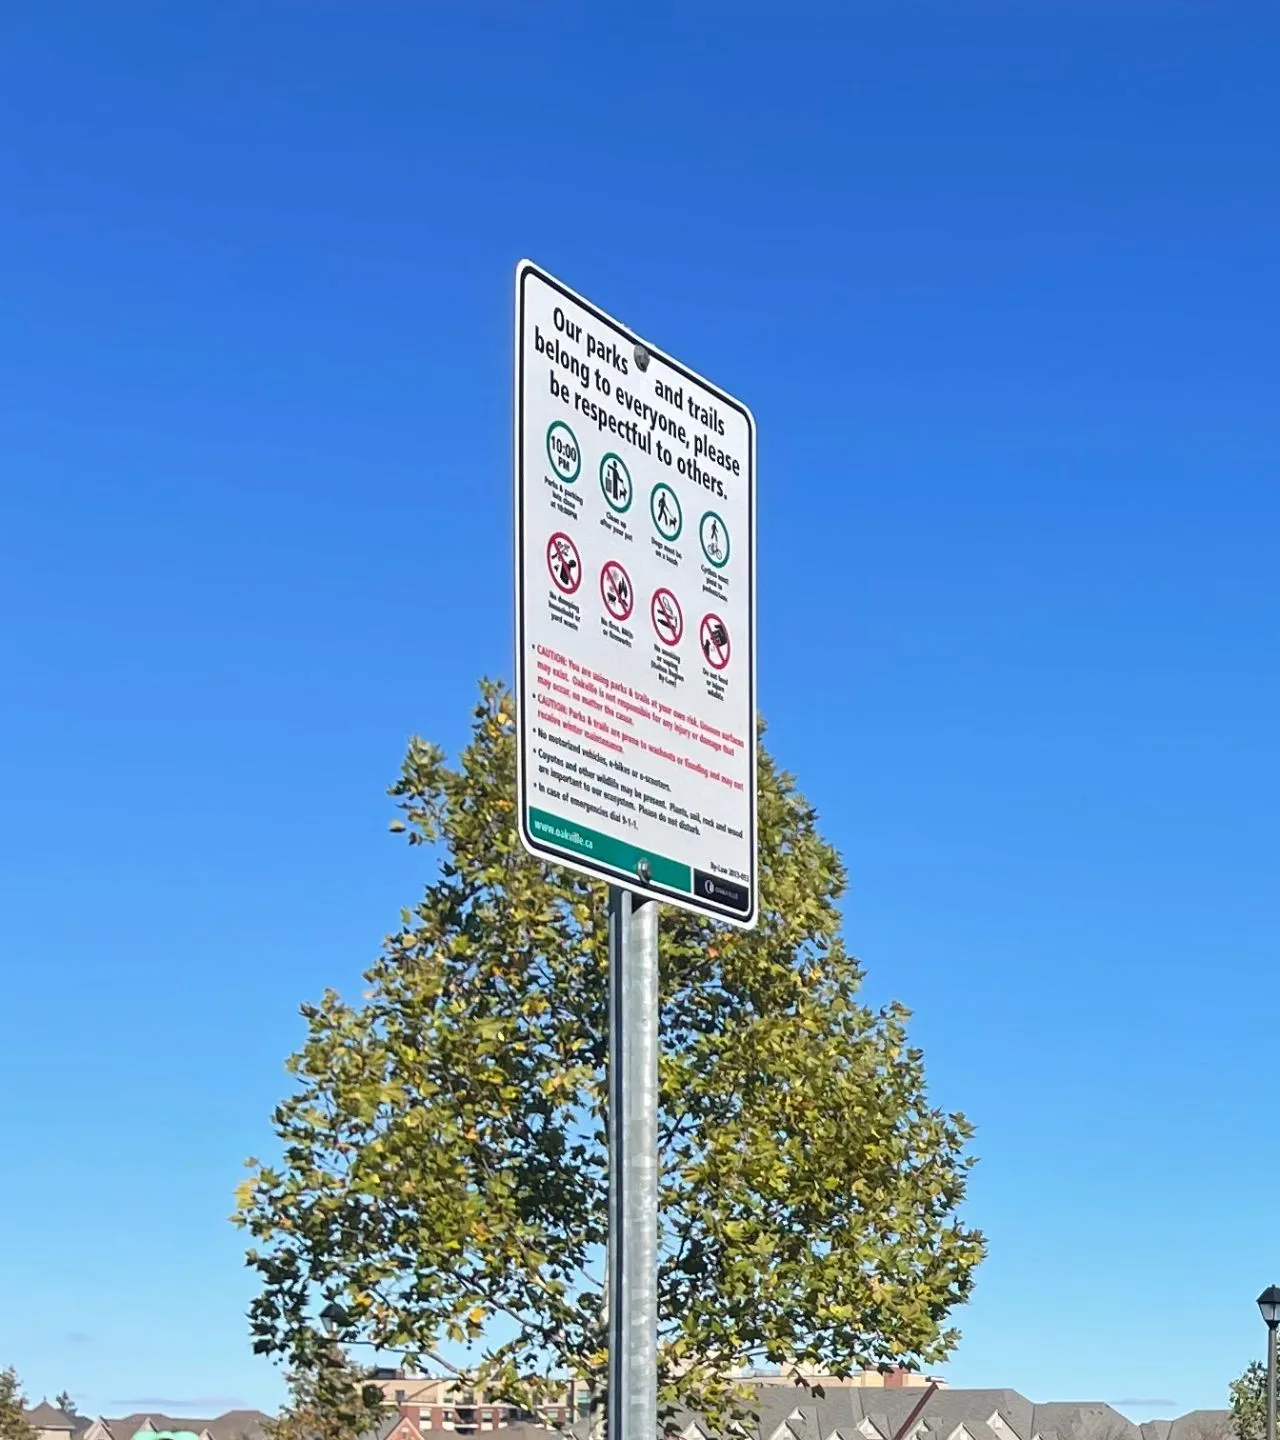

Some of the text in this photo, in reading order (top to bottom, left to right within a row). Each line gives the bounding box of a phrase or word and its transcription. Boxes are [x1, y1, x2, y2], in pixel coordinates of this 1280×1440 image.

[553, 307, 725, 436] Our parks and trails
[535, 325, 740, 477] belong to everyone, please
[550, 369, 727, 500] be respectful to others.
[551, 435, 577, 462] 10:00
[558, 456, 570, 472] PM
[539, 782, 545, 793] In
[534, 820, 593, 849] www.oakville.ca
